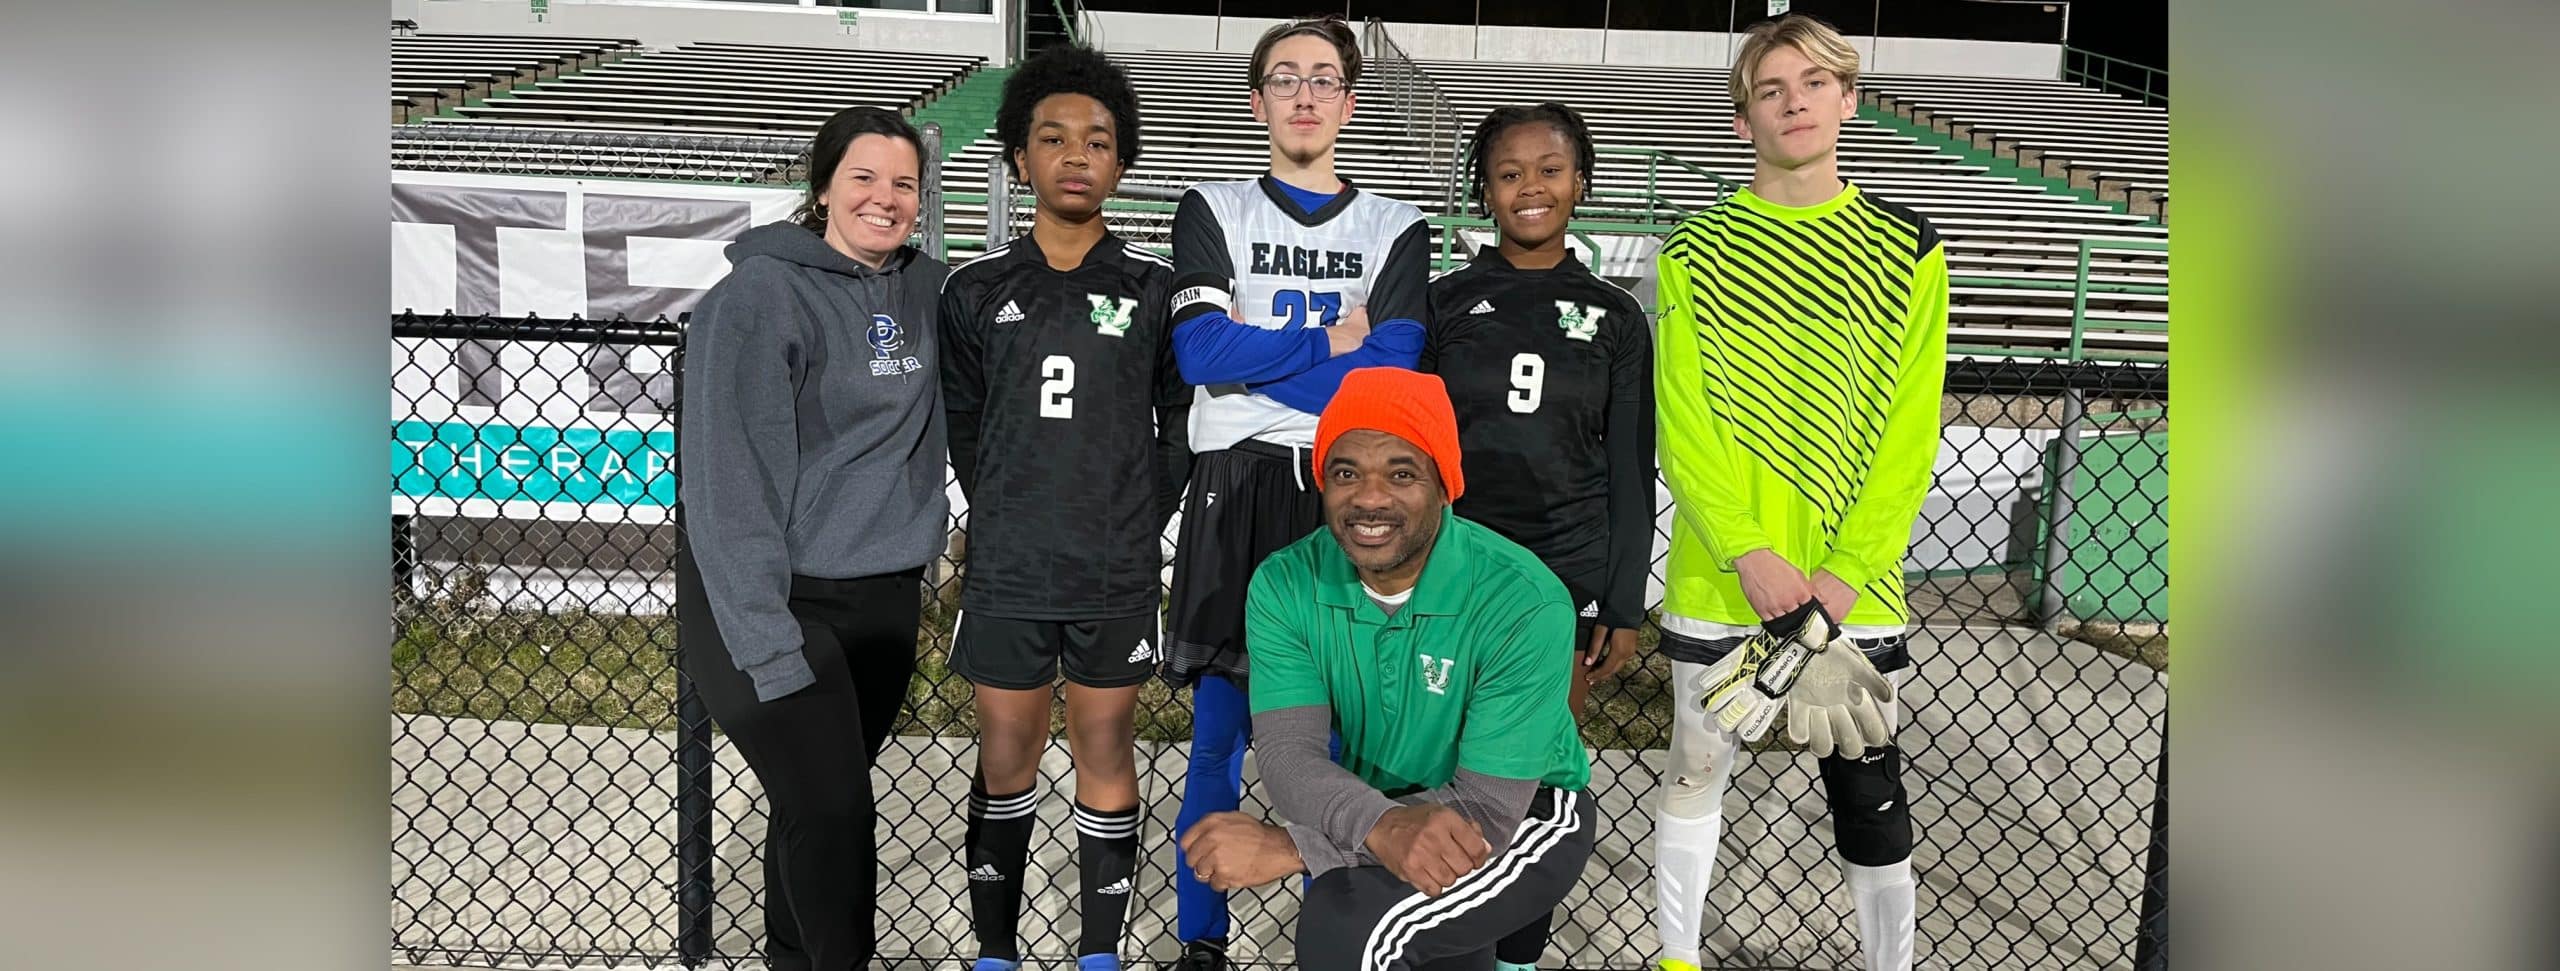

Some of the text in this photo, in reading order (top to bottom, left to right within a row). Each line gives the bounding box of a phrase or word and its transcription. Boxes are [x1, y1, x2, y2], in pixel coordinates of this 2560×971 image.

[1250, 242, 1363, 280] EAGLES
[1170, 287, 1201, 310] PTAIN
[1271, 289, 1342, 331] 27
[995, 312, 1026, 324] adidas
[869, 356, 922, 376] SOCCER
[1507, 353, 1545, 413] 9
[1040, 355, 1075, 419] 2
